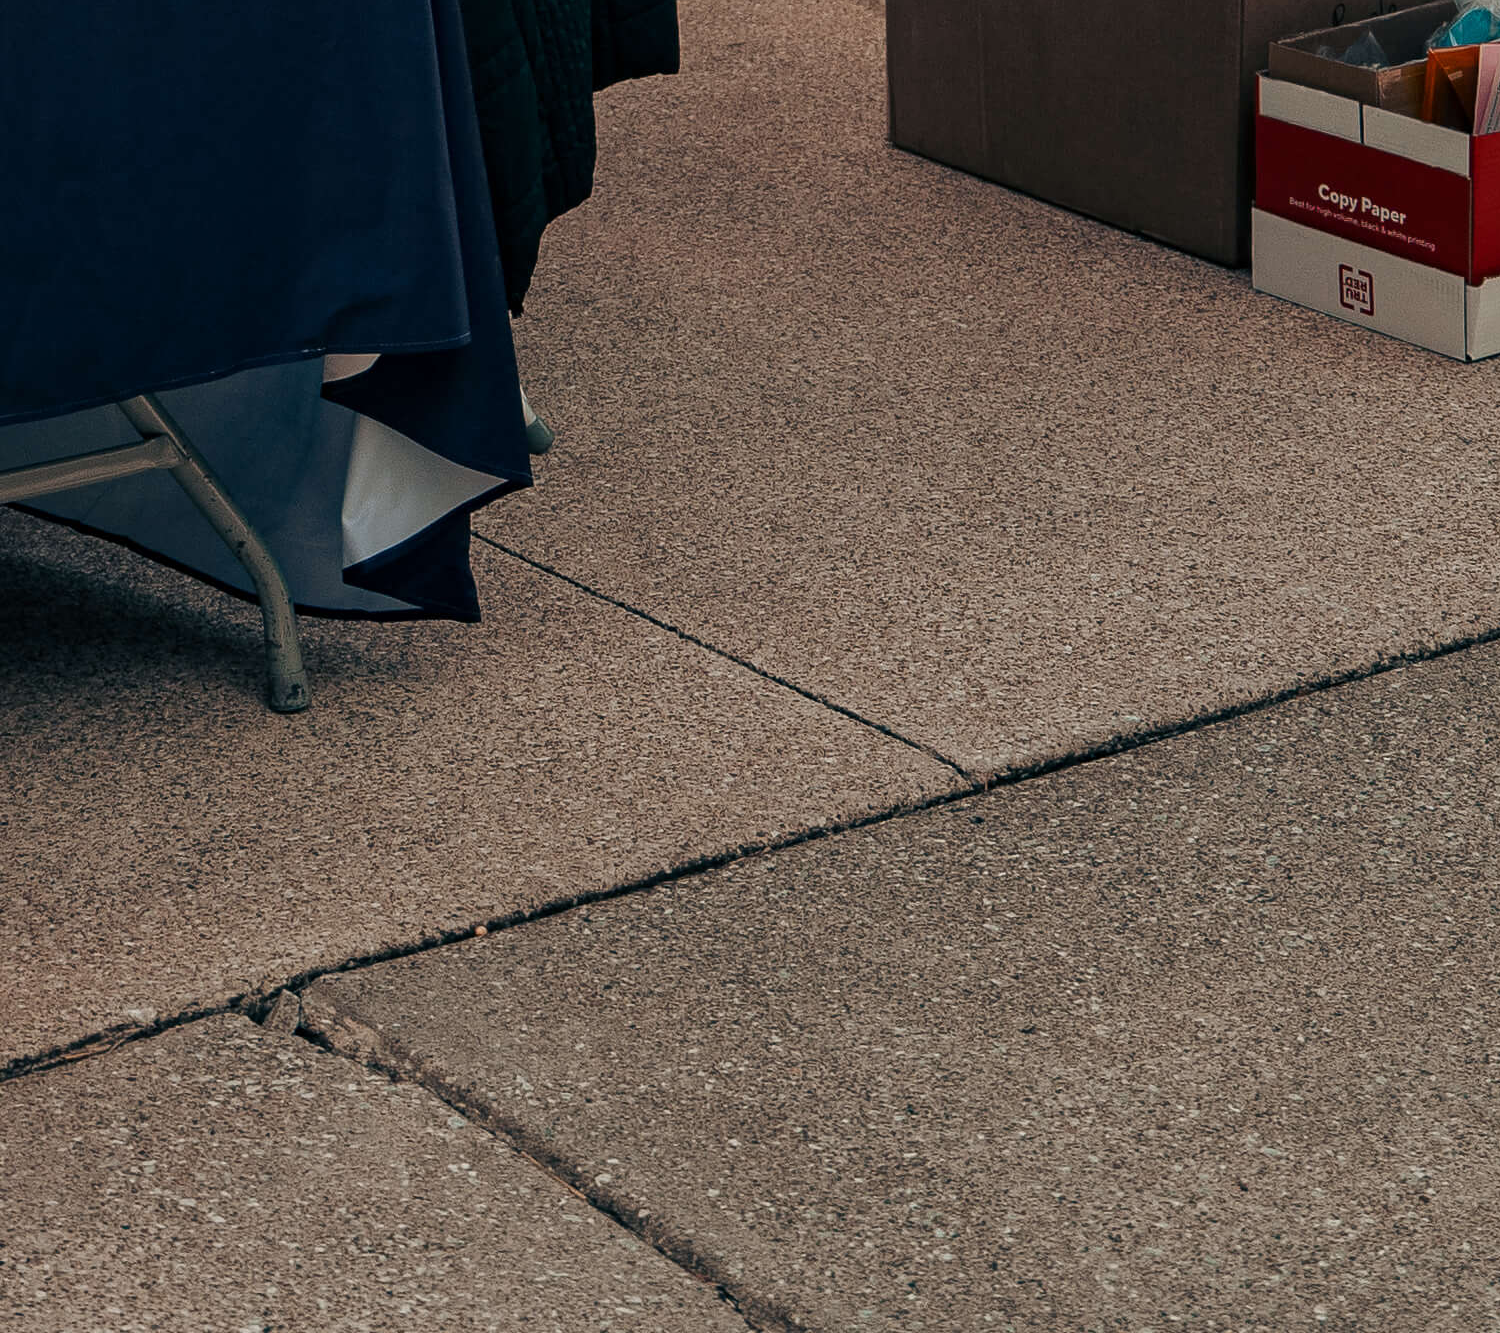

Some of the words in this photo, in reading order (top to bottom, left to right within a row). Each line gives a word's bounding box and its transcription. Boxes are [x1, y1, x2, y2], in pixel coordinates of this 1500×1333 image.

[1318, 183, 1358, 212] Copy
[1361, 196, 1407, 224] Paper
[1289, 196, 1305, 209] Best
[1407, 236, 1436, 252] printing
[1343, 276, 1368, 292] RED
[1345, 288, 1368, 304] TRU
